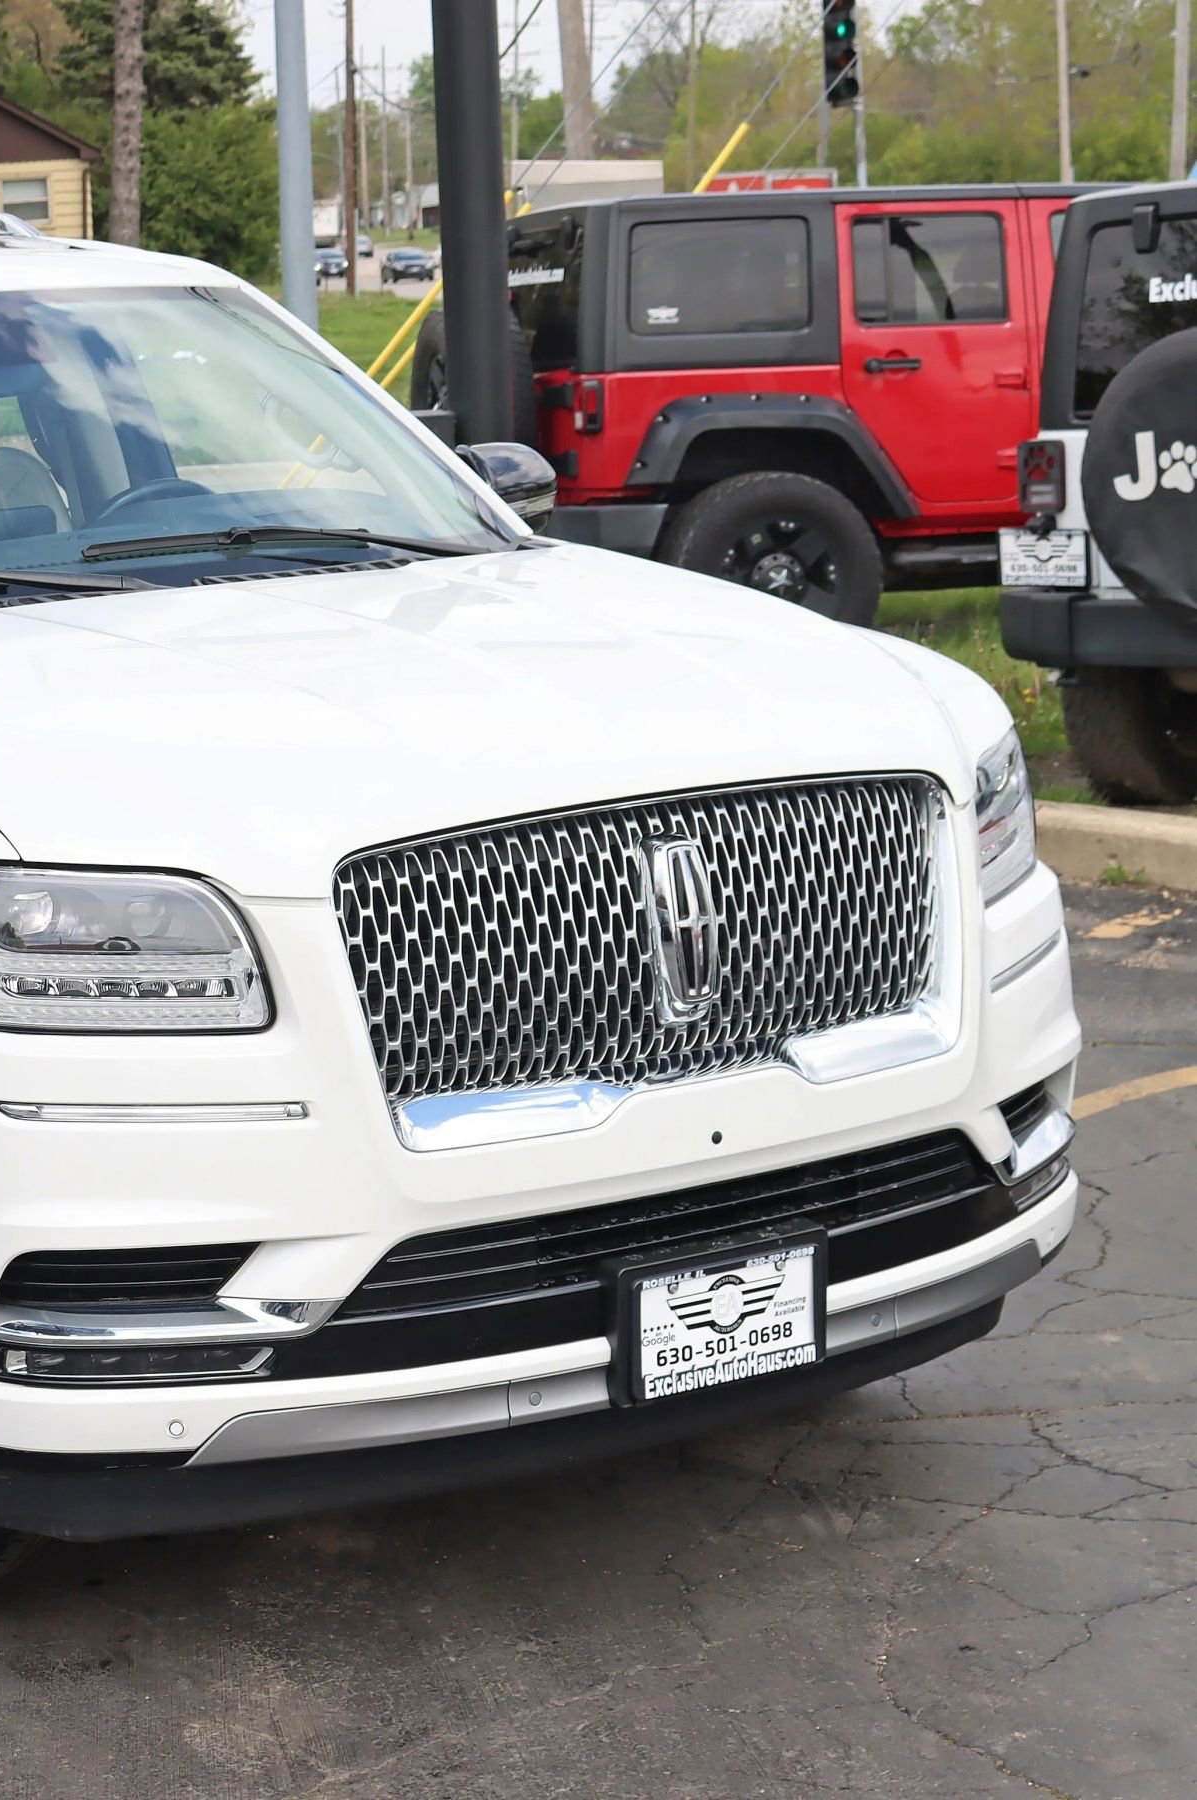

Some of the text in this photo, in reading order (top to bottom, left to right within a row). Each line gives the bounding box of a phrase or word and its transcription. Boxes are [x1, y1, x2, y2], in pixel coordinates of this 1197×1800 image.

[746, 1246, 815, 1268] 630-501-0698
[696, 1270, 706, 1278] IL
[773, 1296, 807, 1308] Financing
[775, 1305, 806, 1317] Available
[642, 1332, 676, 1347] Google
[656, 1321, 793, 1367] 630-501-0698
[644, 1344, 817, 1400] ExclusiveAutoHaus.com
